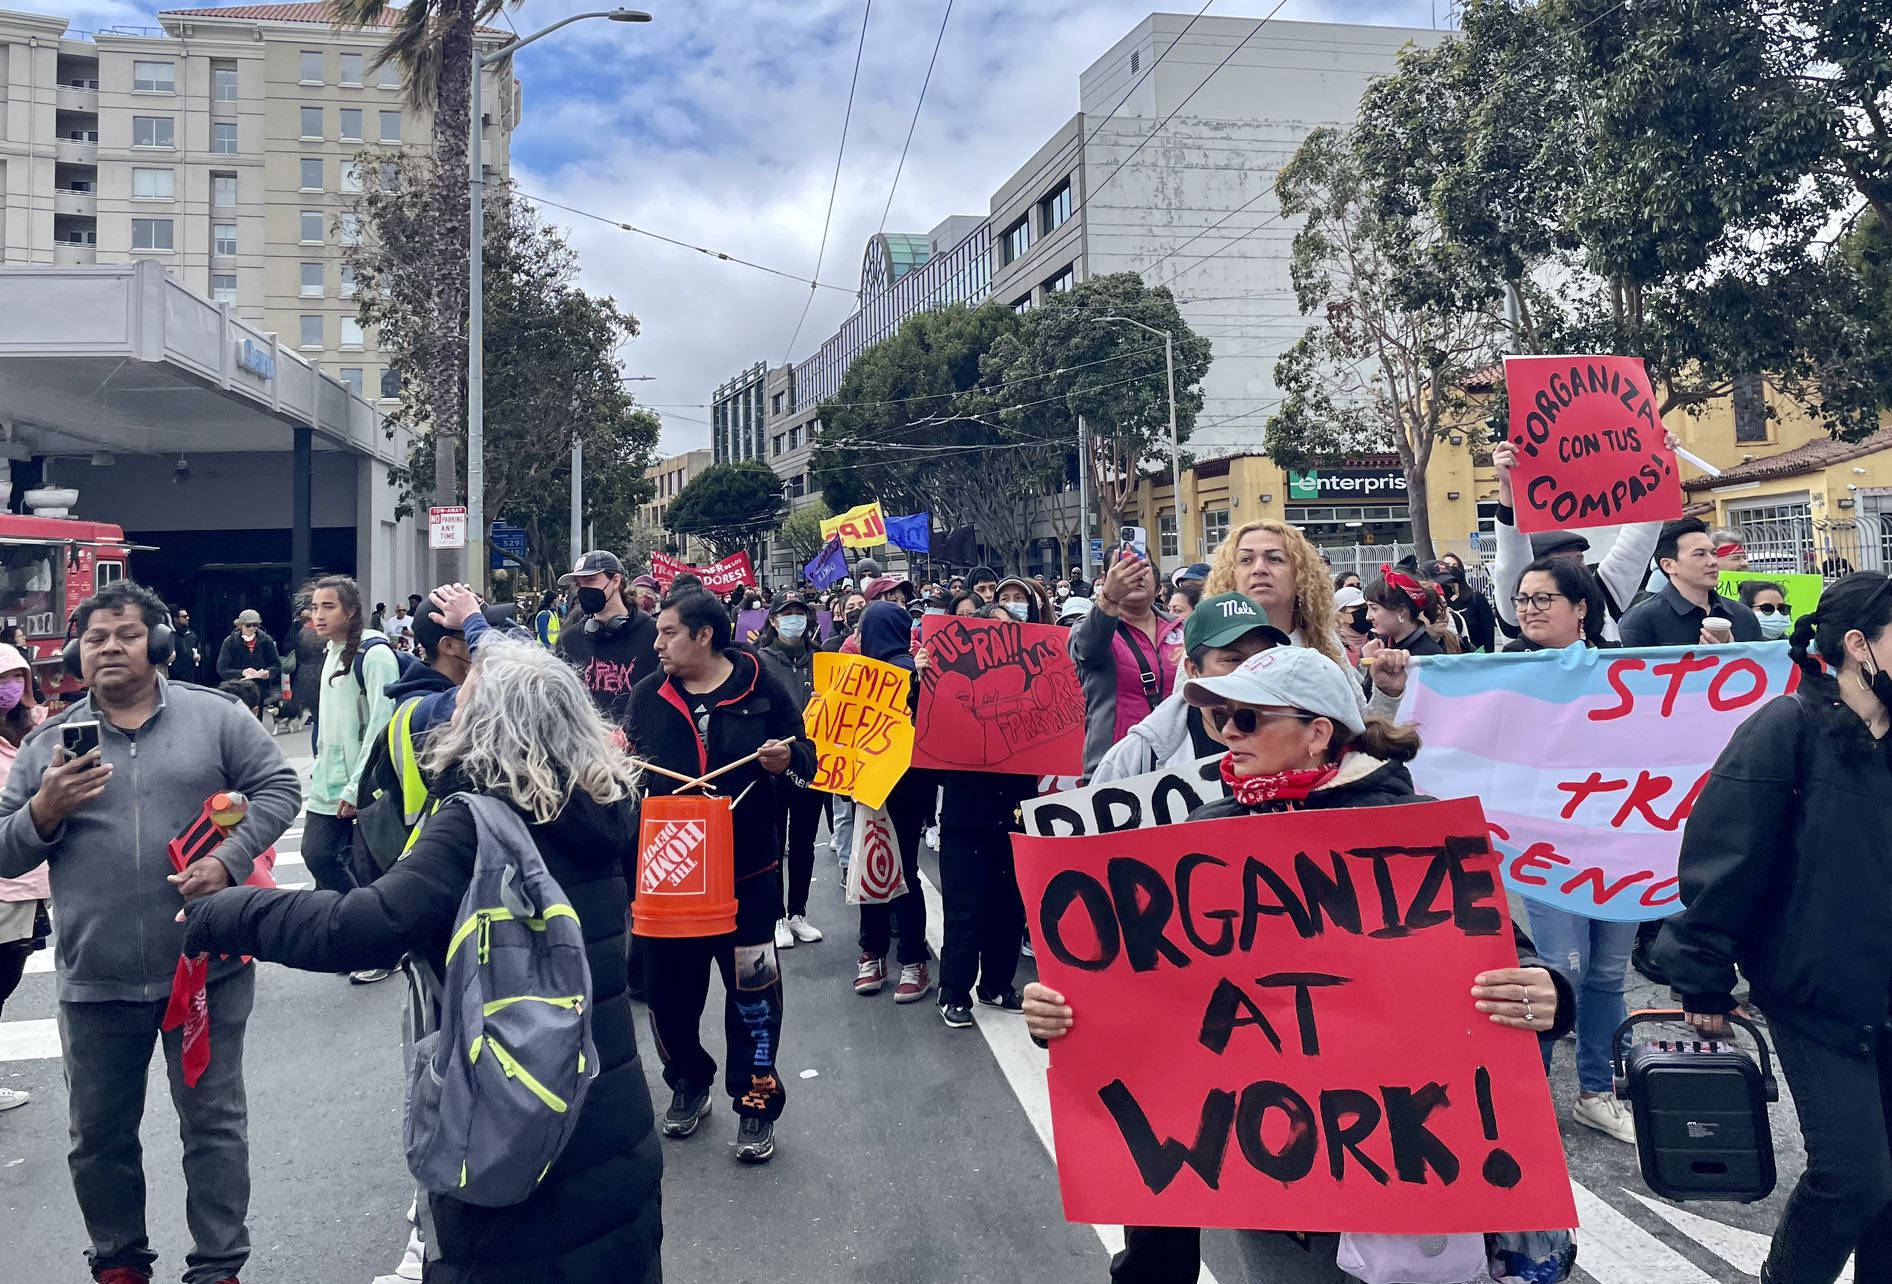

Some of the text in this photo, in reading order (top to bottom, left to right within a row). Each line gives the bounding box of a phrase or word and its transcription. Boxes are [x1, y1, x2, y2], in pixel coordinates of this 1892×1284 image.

[1559, 427, 1642, 463] CON TUS
[1528, 454, 1671, 523] COMPAS!
[431, 514, 440, 523] NO
[440, 532, 456, 540] TIME
[1216, 599, 1257, 618] Mels
[641, 821, 705, 893] HOME
[667, 857, 698, 887] THE
[1040, 836, 1502, 972] ORGANIZE
[1199, 972, 1354, 1057] AT
[1097, 1064, 1523, 1196] WORK!
